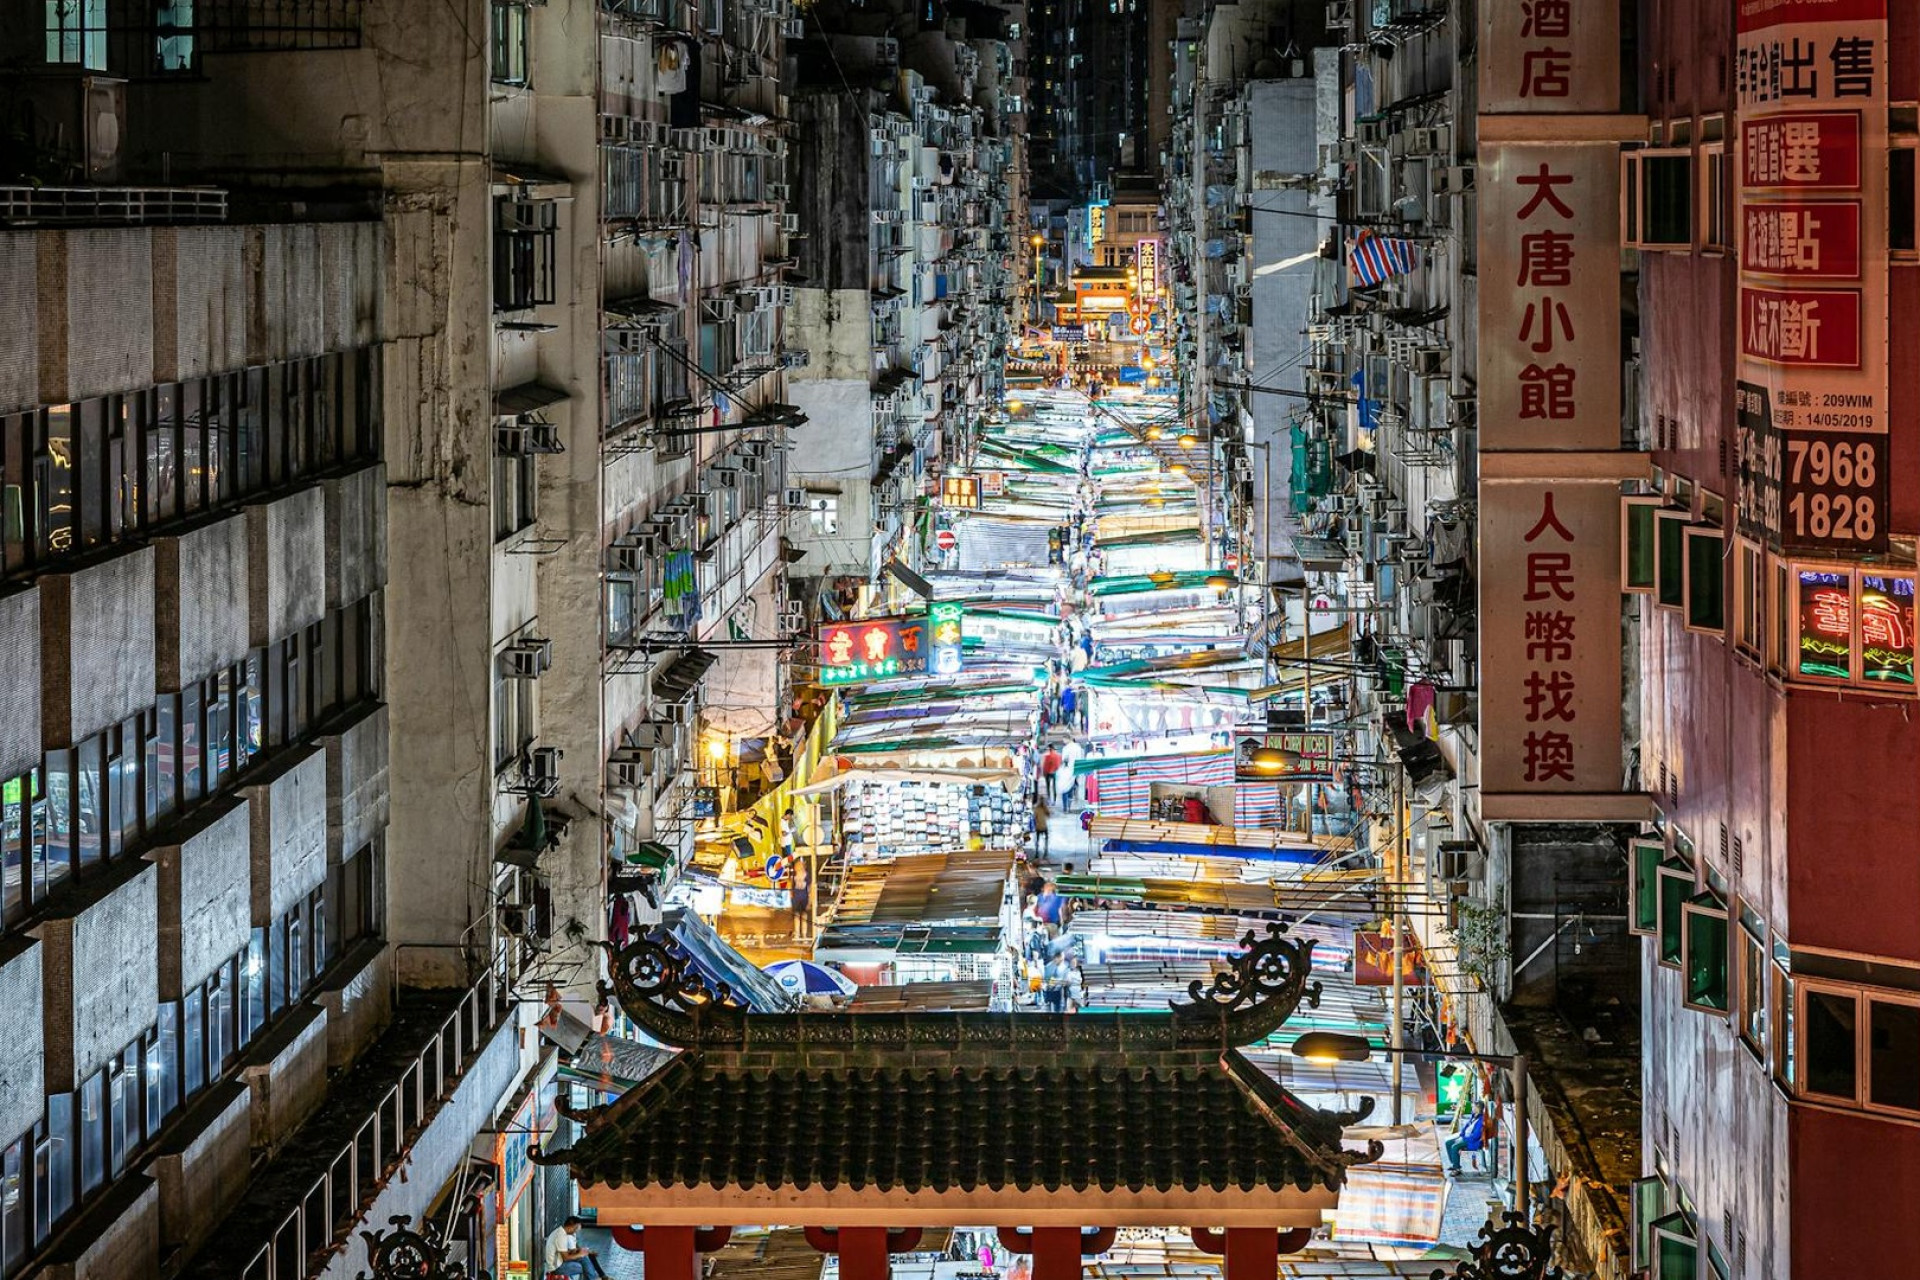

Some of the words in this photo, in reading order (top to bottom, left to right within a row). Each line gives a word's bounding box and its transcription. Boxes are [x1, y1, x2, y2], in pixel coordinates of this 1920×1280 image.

[1519, 0, 1572, 98] 酒店
[1516, 163, 1576, 419] 大唐小館
[1747, 294, 1821, 360] 人流不斷
[1806, 413, 1873, 428] 14/05/2019
[1823, 394, 1873, 408] 209WIM
[1787, 440, 1876, 488] 7968
[1789, 492, 1876, 541] 1828
[1523, 491, 1575, 782] 人民幣找換
